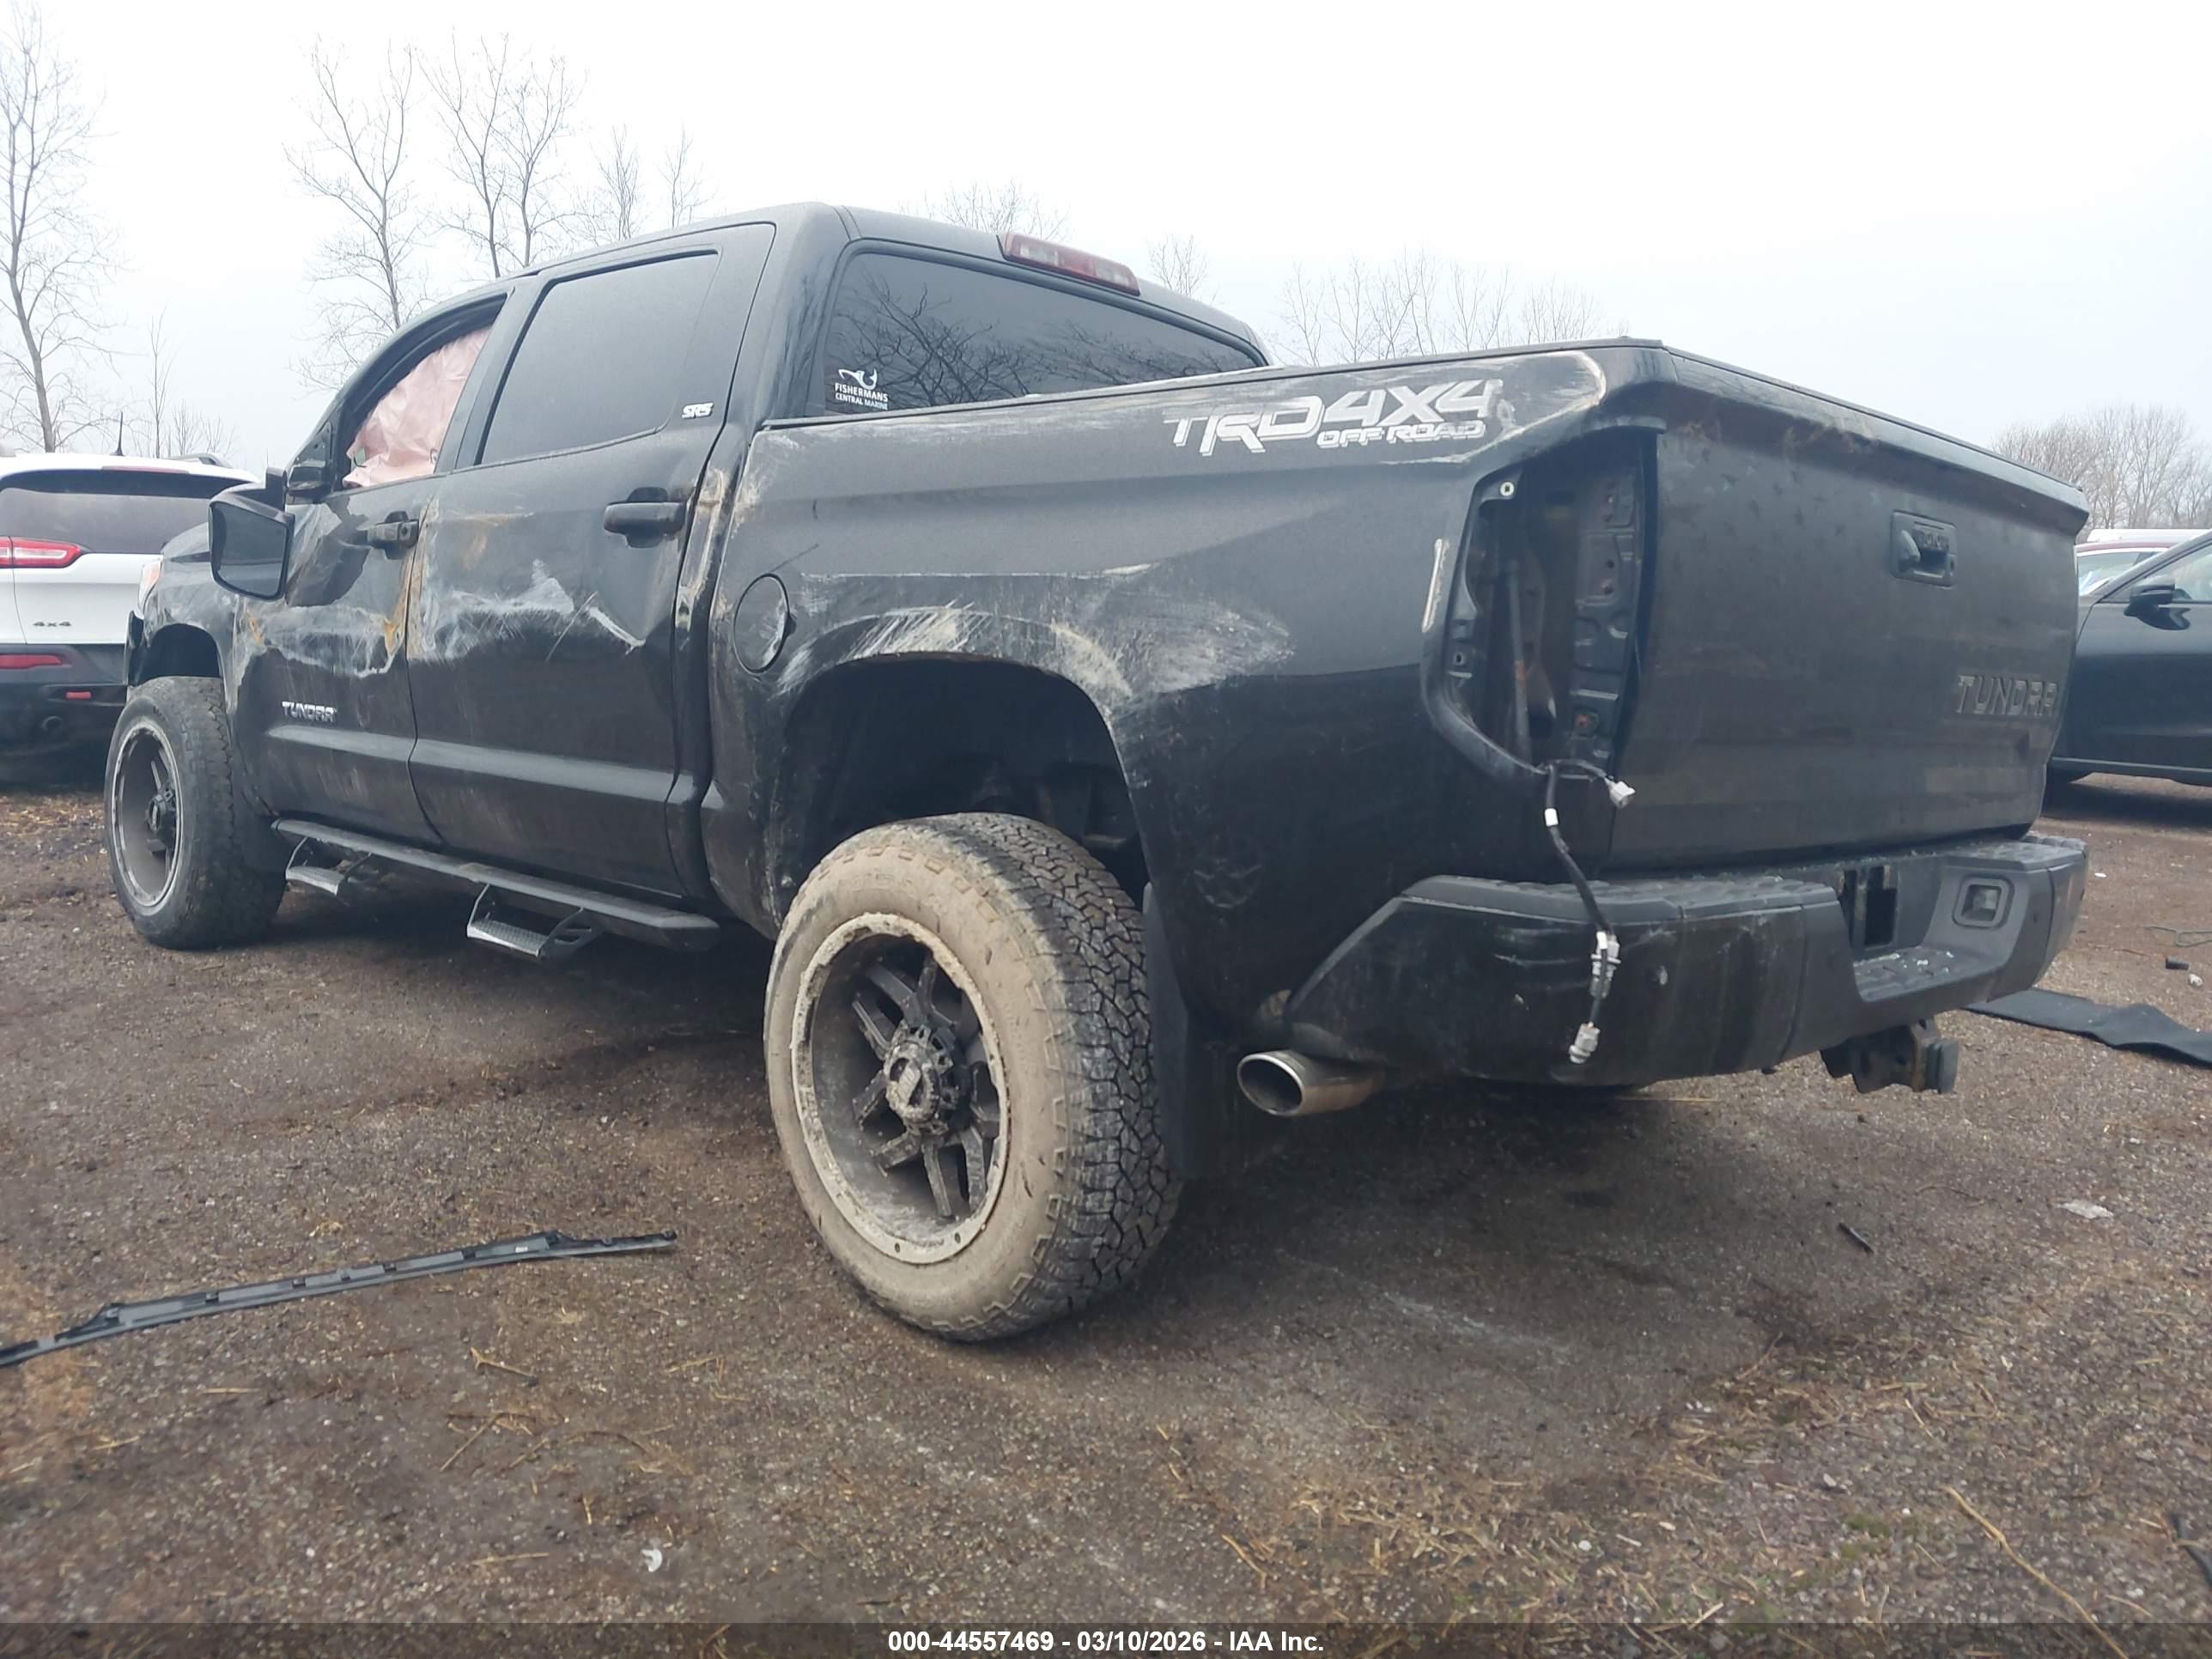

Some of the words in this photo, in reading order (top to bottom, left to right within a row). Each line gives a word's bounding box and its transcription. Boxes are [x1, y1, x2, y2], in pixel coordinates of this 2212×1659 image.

[835, 382, 888, 402] FISHERMANS
[836, 392, 863, 405] CENTRAL
[864, 399, 888, 410] MARINE
[1163, 395, 1326, 456] TRD
[1316, 428, 1386, 448] OFF
[1387, 419, 1486, 444] ROAD
[1956, 674, 2058, 716] TUNDRA
[282, 701, 337, 722] TUNDRA
